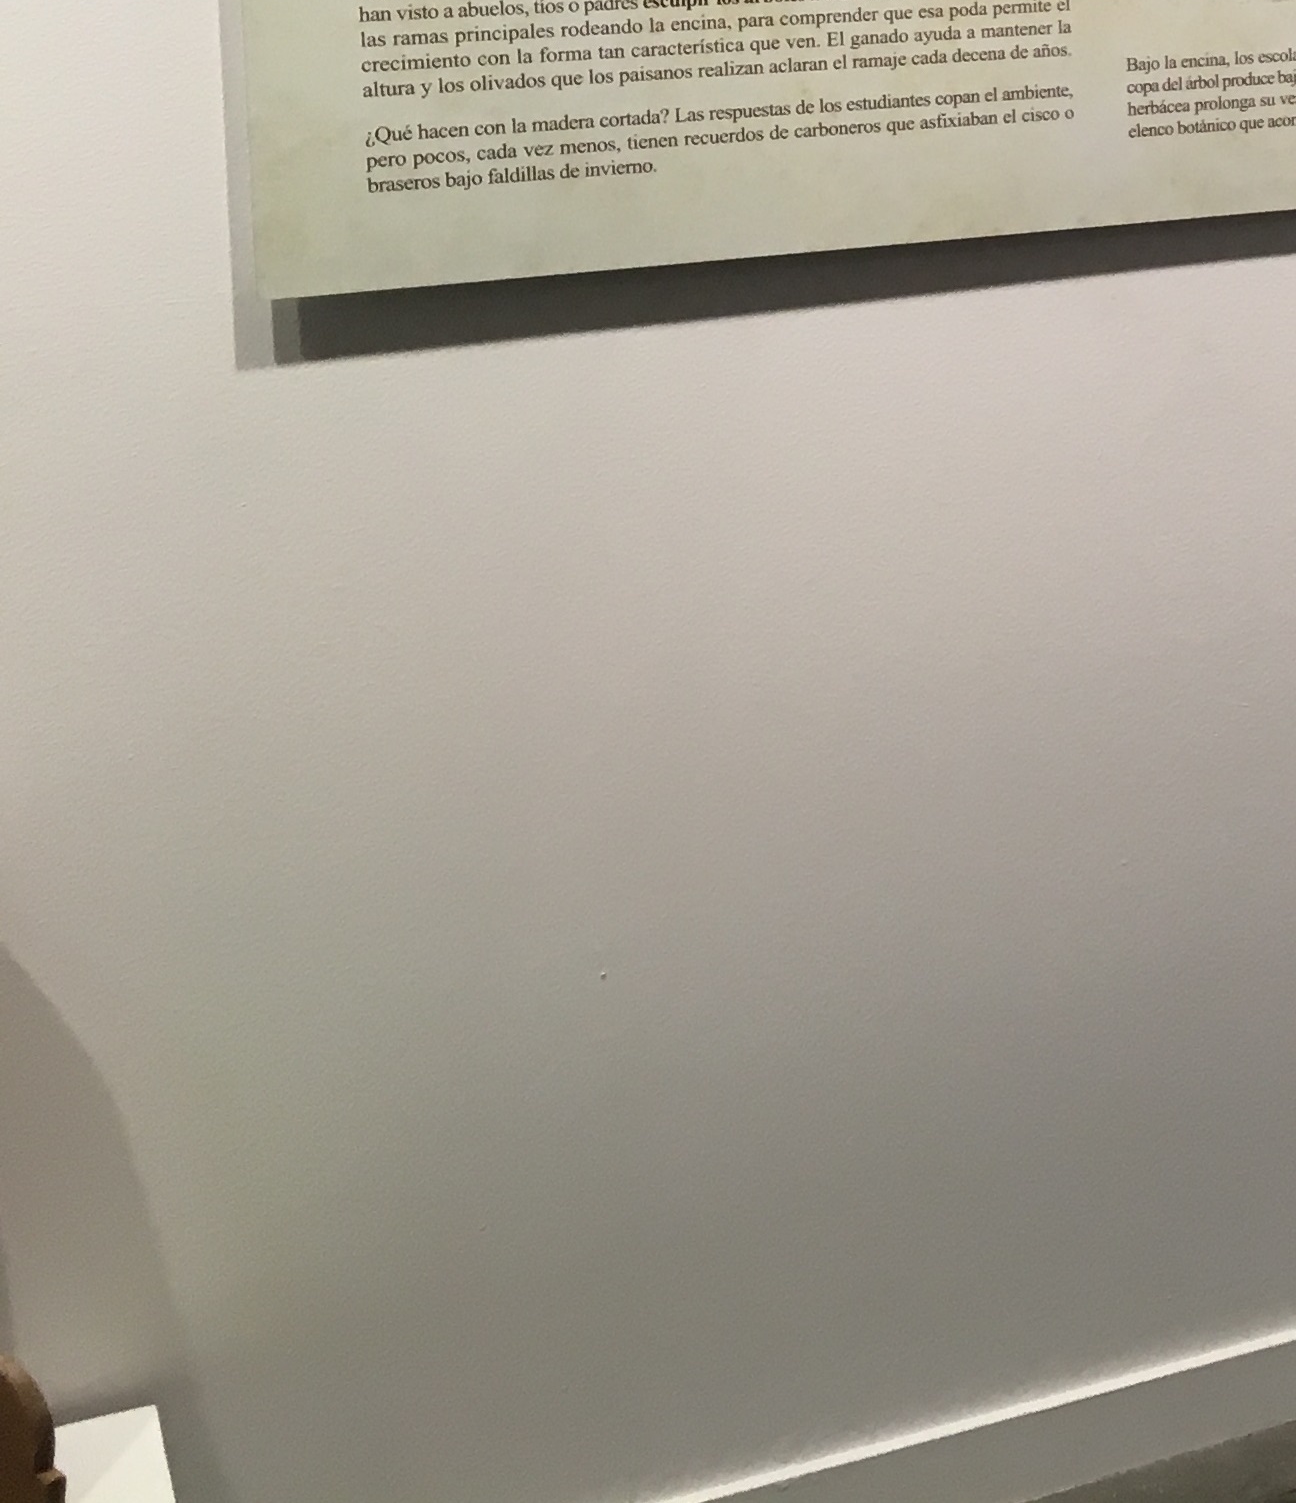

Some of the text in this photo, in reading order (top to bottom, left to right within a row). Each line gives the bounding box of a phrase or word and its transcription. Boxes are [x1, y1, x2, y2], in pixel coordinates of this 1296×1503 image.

[358, 5, 391, 22] han
[396, 3, 439, 21] visto
[443, 6, 454, 18] a
[457, 0, 529, 18] abuelos,
[568, 0, 579, 13] o
[362, 43, 1071, 99] altura y los olivados que los paisanos realizan aclaran el ramaje cada decena de años.
[1125, 55, 1160, 75] Bajo
[1164, 54, 1177, 69] la
[1234, 50, 1254, 65] los
[365, 83, 1073, 148] ¿Qué hacen con la madera cortada? Las respuestas de los estudiantes copan el ambiente,
[1126, 99, 1190, 116] herbácea
[1193, 95, 1256, 116] prolonga
[1259, 95, 1276, 107] su
[365, 106, 1074, 173] pero pocos, cada vez menos, tienen recuerdos de carboneros que asfixiaban el cisco o
[1127, 122, 1174, 139] elenco
[1176, 117, 1236, 135] botánico
[1238, 118, 1264, 134] que
[366, 159, 656, 193] braseros bajo faldillas de invierno.
